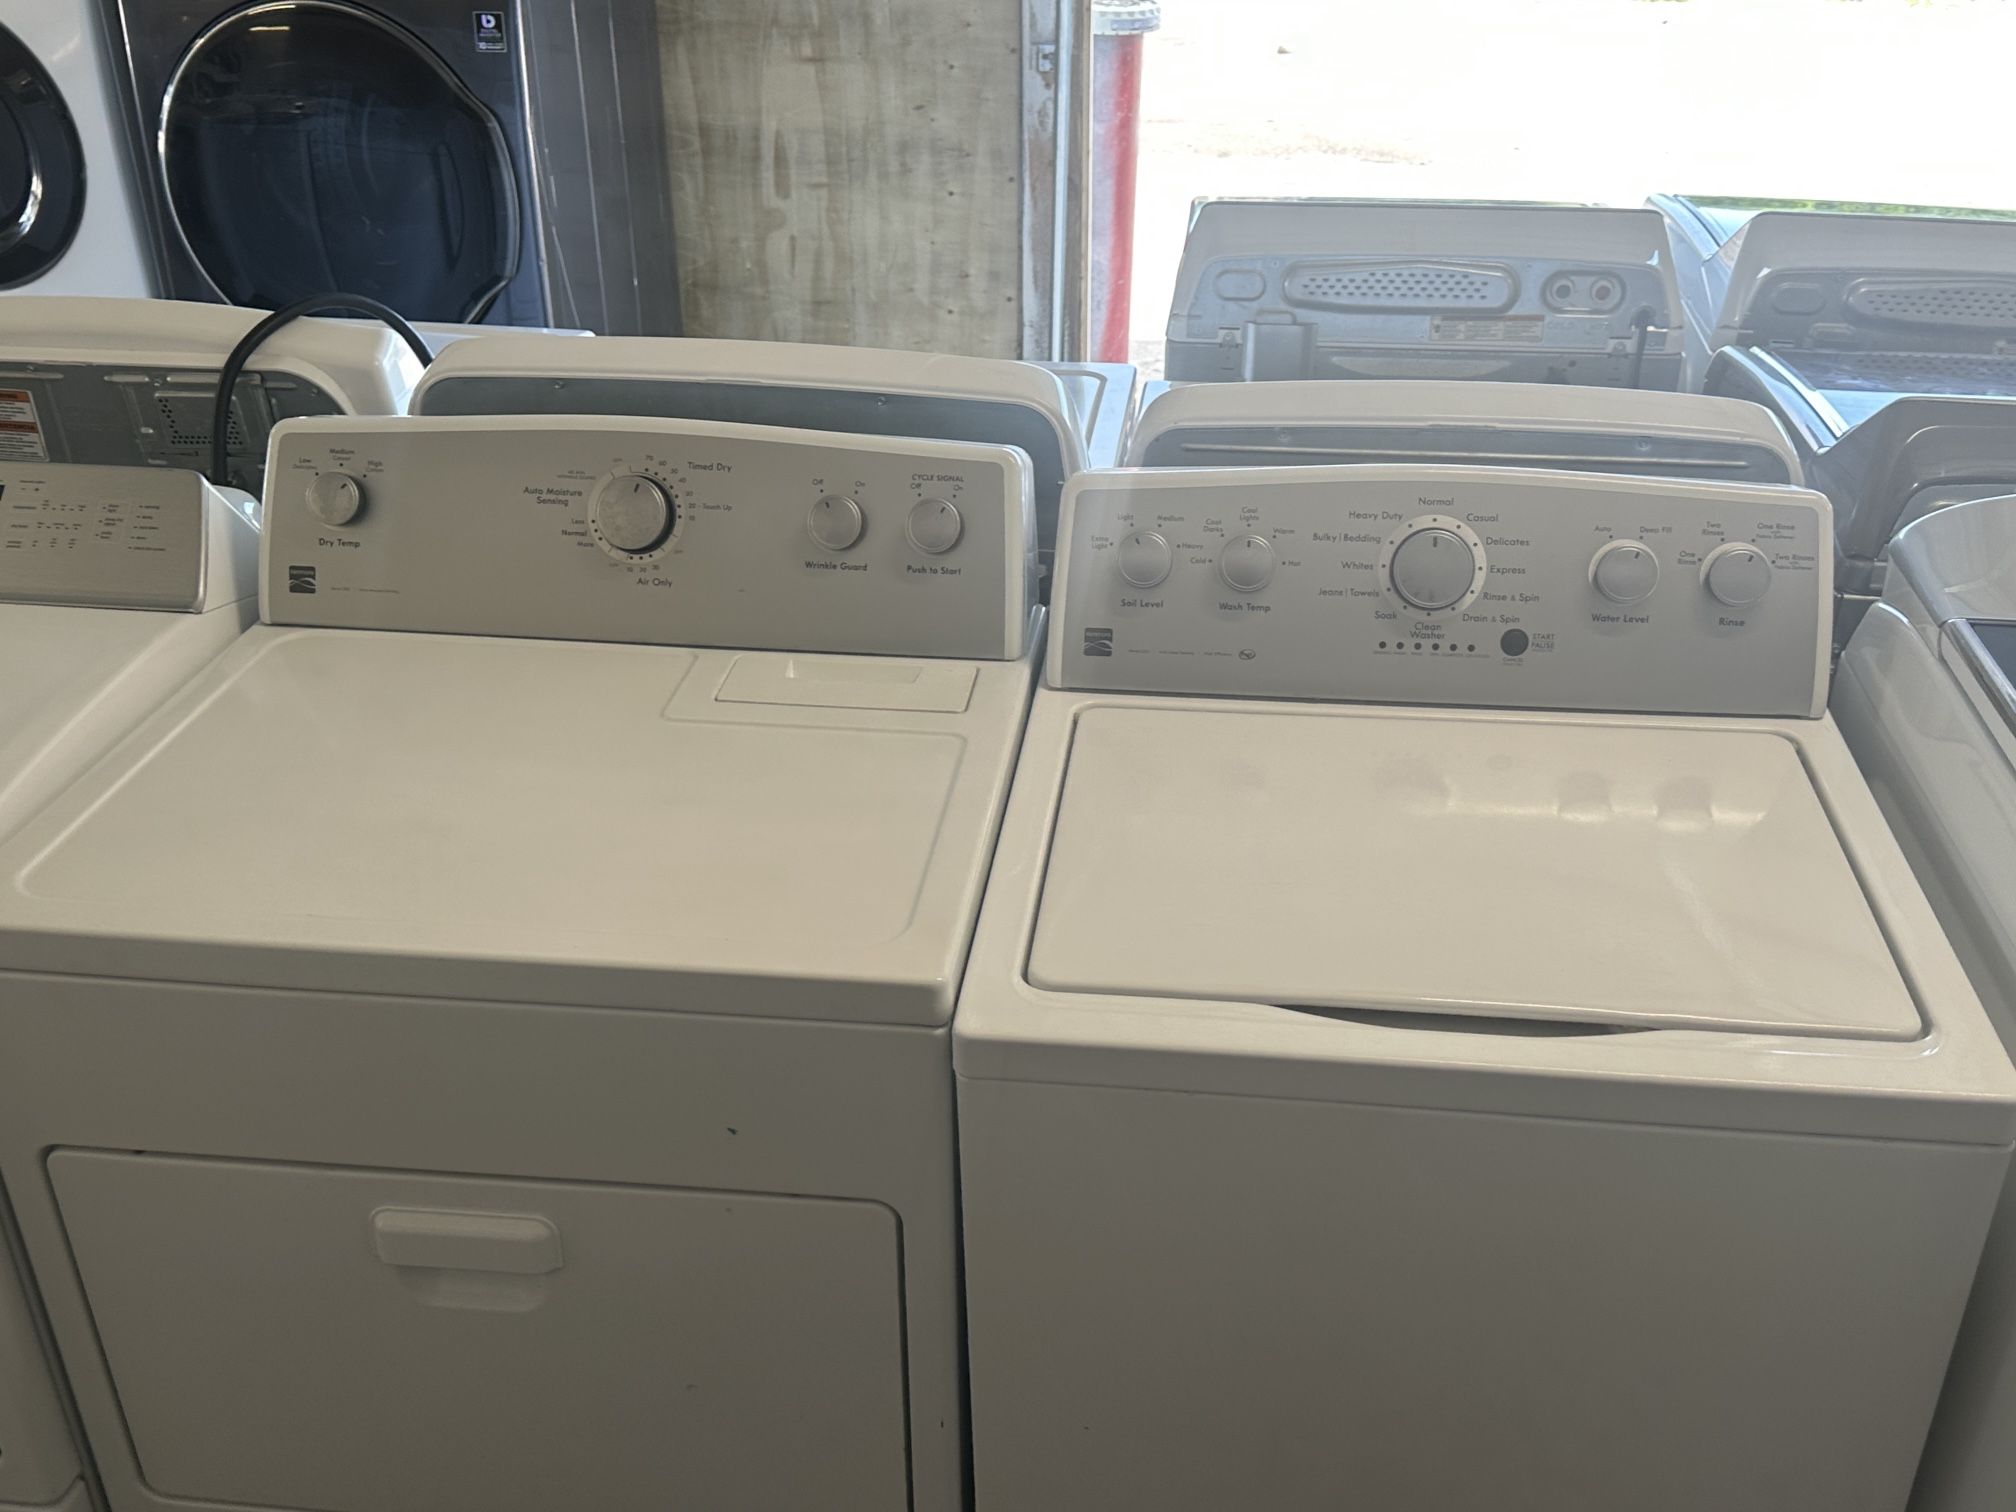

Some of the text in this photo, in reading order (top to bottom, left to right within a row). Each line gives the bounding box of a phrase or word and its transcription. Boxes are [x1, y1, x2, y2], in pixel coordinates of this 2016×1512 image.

[687, 461, 733, 473] Timed Dry
[911, 473, 964, 483] CYCLE SIGNAL
[523, 486, 583, 497] Auto Moisture
[536, 495, 569, 507] Sensing
[1418, 497, 1455, 506] Normal
[702, 503, 721, 511] Touch
[1117, 512, 1134, 521] Light
[1348, 510, 1404, 521] Heavy Duty
[1466, 512, 1499, 522] Casual
[1593, 525, 1612, 533] Auto
[1639, 526, 1660, 534] Deep
[1706, 521, 1721, 529] Two
[1756, 522, 1774, 530] One
[318, 538, 361, 549] Dry Temp
[1312, 533, 1382, 545] Bulky Bedding
[1486, 537, 1530, 547] Delicates
[1679, 550, 1696, 558] One
[1775, 552, 1815, 561] Two Rinses
[805, 561, 868, 572] Wrinkle Guard
[906, 565, 961, 576] Push to Start
[1340, 561, 1374, 570] Whites
[1489, 564, 1526, 576] Express
[637, 577, 673, 588] Air Only
[1318, 588, 1380, 598] Jeans Towels
[1482, 592, 1508, 601] Rinse
[1519, 593, 1540, 603] Spin
[1120, 598, 1164, 609] Soil Level
[1219, 602, 1271, 614] Wash Temp
[1374, 610, 1398, 620] Soak
[1462, 613, 1488, 623] Drain
[1499, 615, 1520, 625] Spin
[1591, 613, 1650, 624] Water Level
[1414, 621, 1442, 631] Clean
[1718, 617, 1746, 627] Rinse
[1409, 630, 1446, 640] Washer
[1531, 641, 1554, 649] PAUSE
